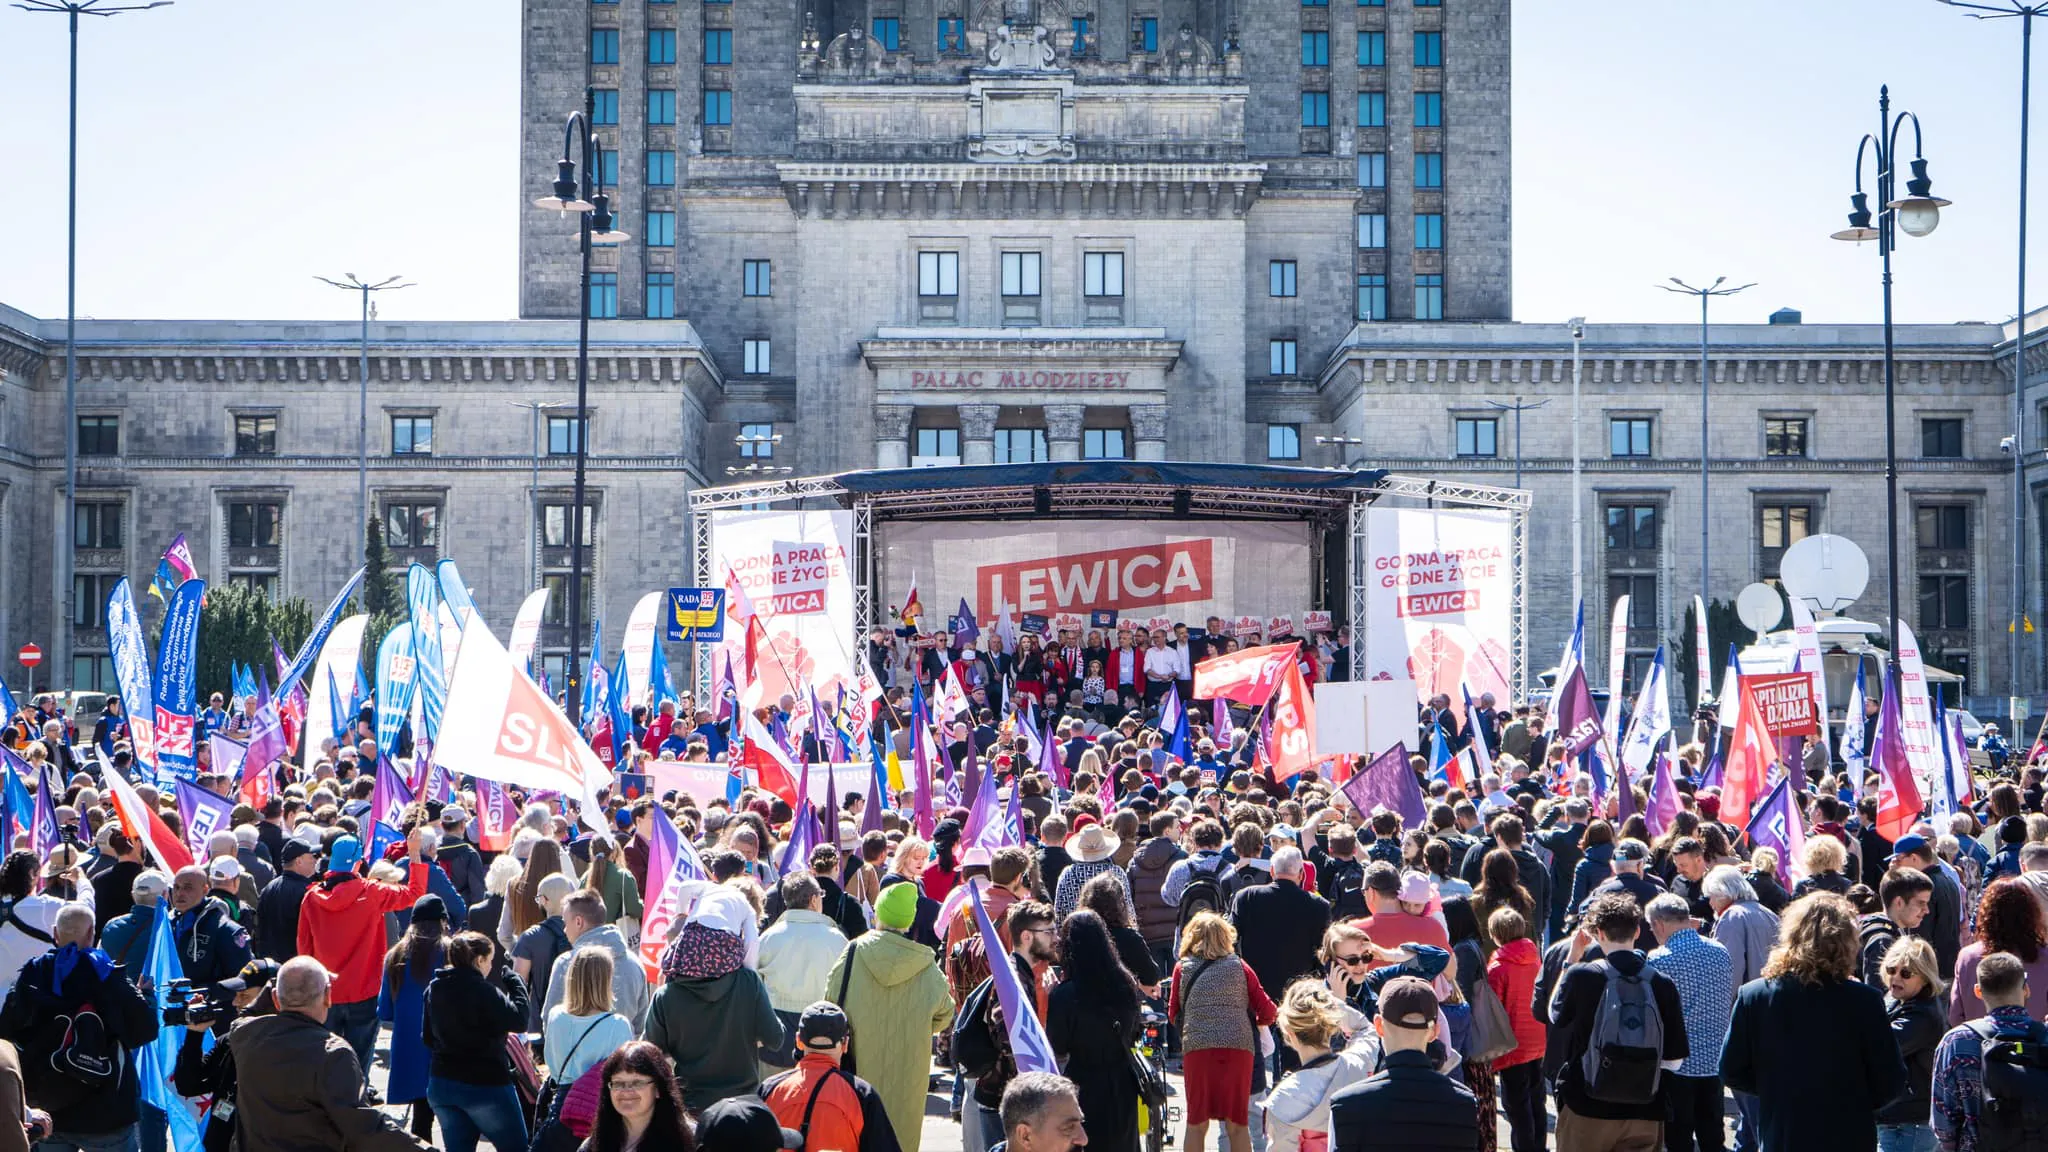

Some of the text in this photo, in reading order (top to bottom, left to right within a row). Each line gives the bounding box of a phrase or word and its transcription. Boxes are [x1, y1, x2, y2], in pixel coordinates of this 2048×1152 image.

[911, 371, 984, 388] PAŁAC
[788, 545, 846, 564] PRACA
[1375, 545, 1503, 570] GODNA PRACA
[743, 564, 839, 589] ODNE ŻYCIE
[991, 551, 1201, 615] LEWICA
[1381, 565, 1496, 588] GODNE ŻYCIE
[678, 594, 699, 603] RADA
[756, 593, 821, 617] EWICA
[1400, 591, 1476, 617] LEWICA
[1754, 682, 1808, 706] PITALIZM
[1767, 700, 1811, 724] DZIAŁA
